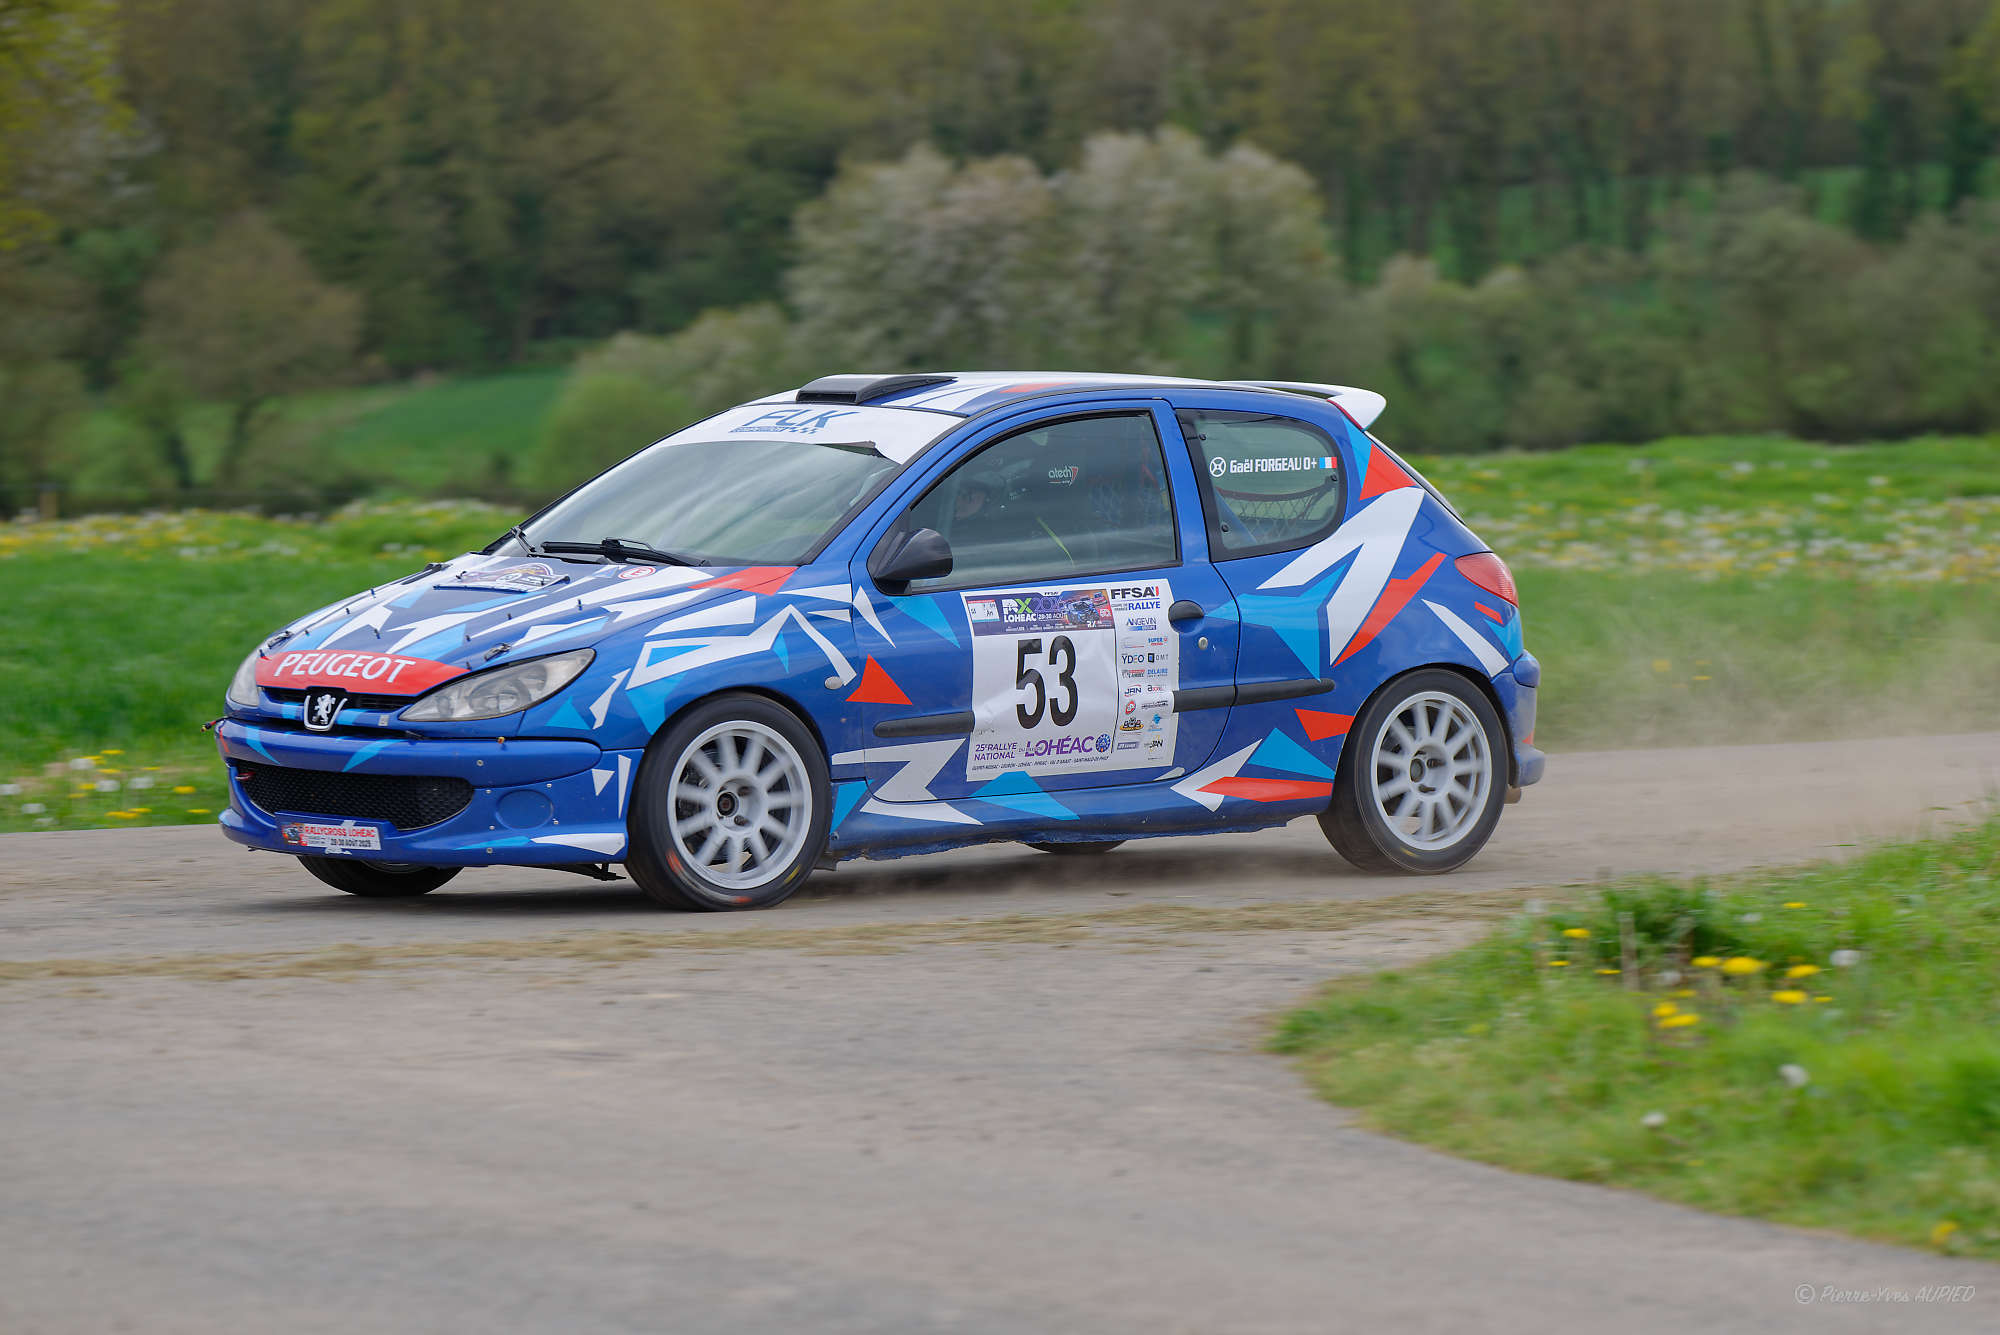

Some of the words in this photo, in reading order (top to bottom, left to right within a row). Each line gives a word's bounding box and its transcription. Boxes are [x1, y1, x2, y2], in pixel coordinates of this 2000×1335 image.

[1230, 459, 1254, 474] Gaël
[1255, 457, 1302, 473] FORGEAU
[1128, 600, 1161, 611] RALLYE
[1003, 612, 1038, 623] LOHEAC
[1126, 616, 1157, 626] ANGEVIN
[273, 653, 417, 684] PEUGEOT
[1015, 635, 1079, 730] 53
[987, 742, 1017, 752] RALLYE
[1024, 735, 1095, 758] LOHÉAC
[974, 751, 1016, 761] NATIONAL
[304, 826, 347, 837] RALLYCROSS
